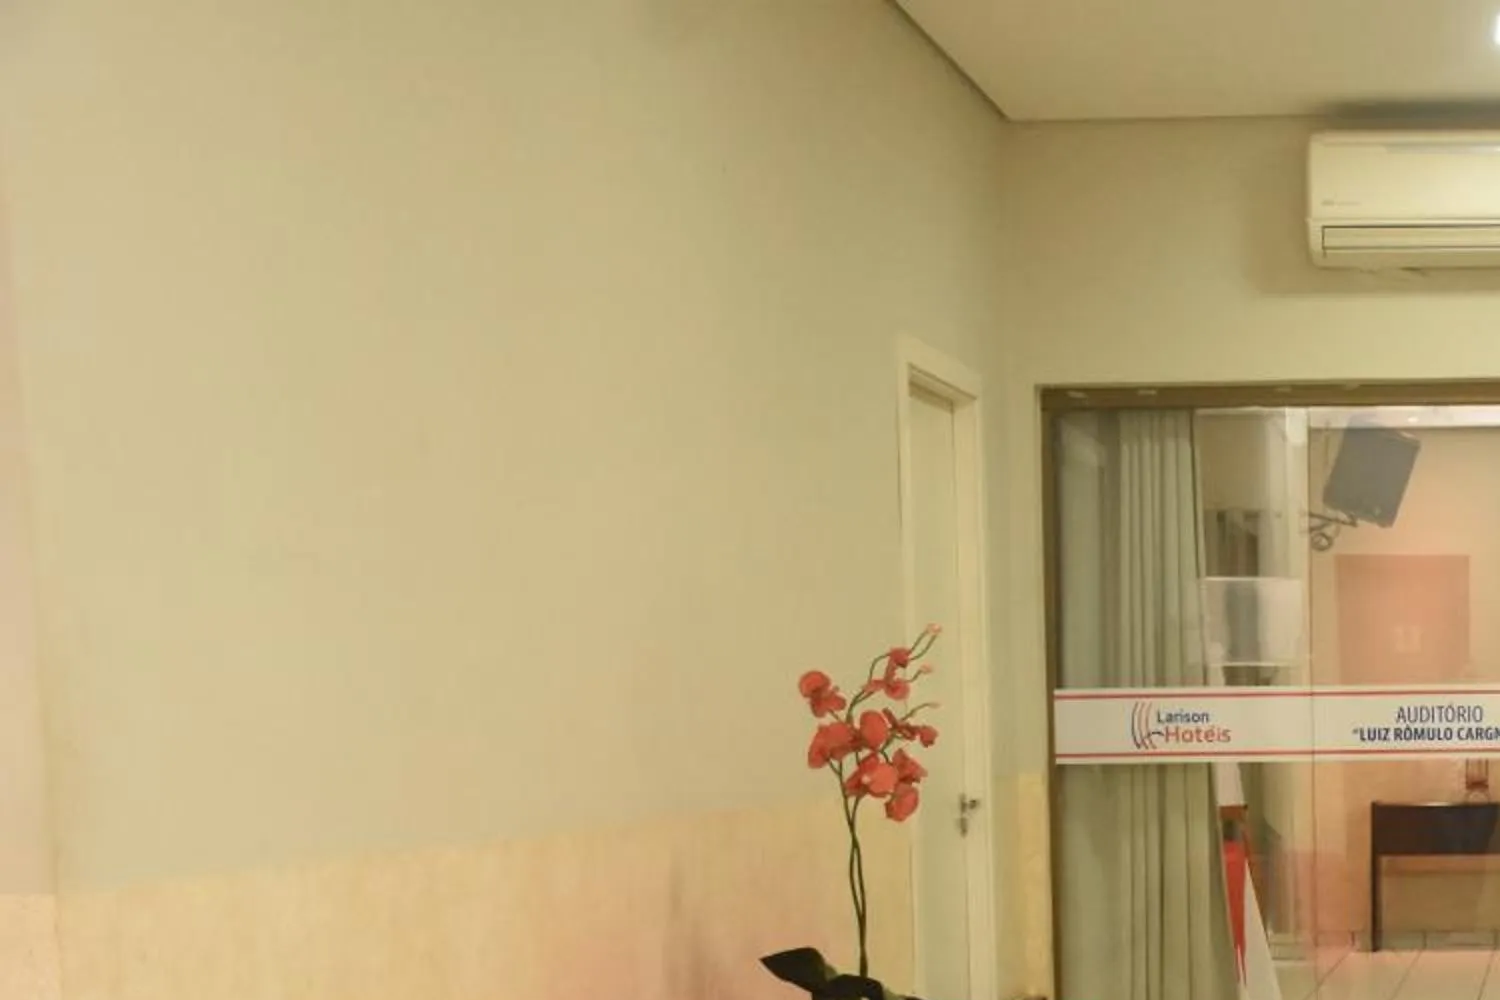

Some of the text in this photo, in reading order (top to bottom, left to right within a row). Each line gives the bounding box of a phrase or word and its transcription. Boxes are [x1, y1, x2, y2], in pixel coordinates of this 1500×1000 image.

[1157, 708, 1210, 724] Larison
[1396, 704, 1484, 723] AUDITÓRIO
[1165, 725, 1232, 743] Hotéis
